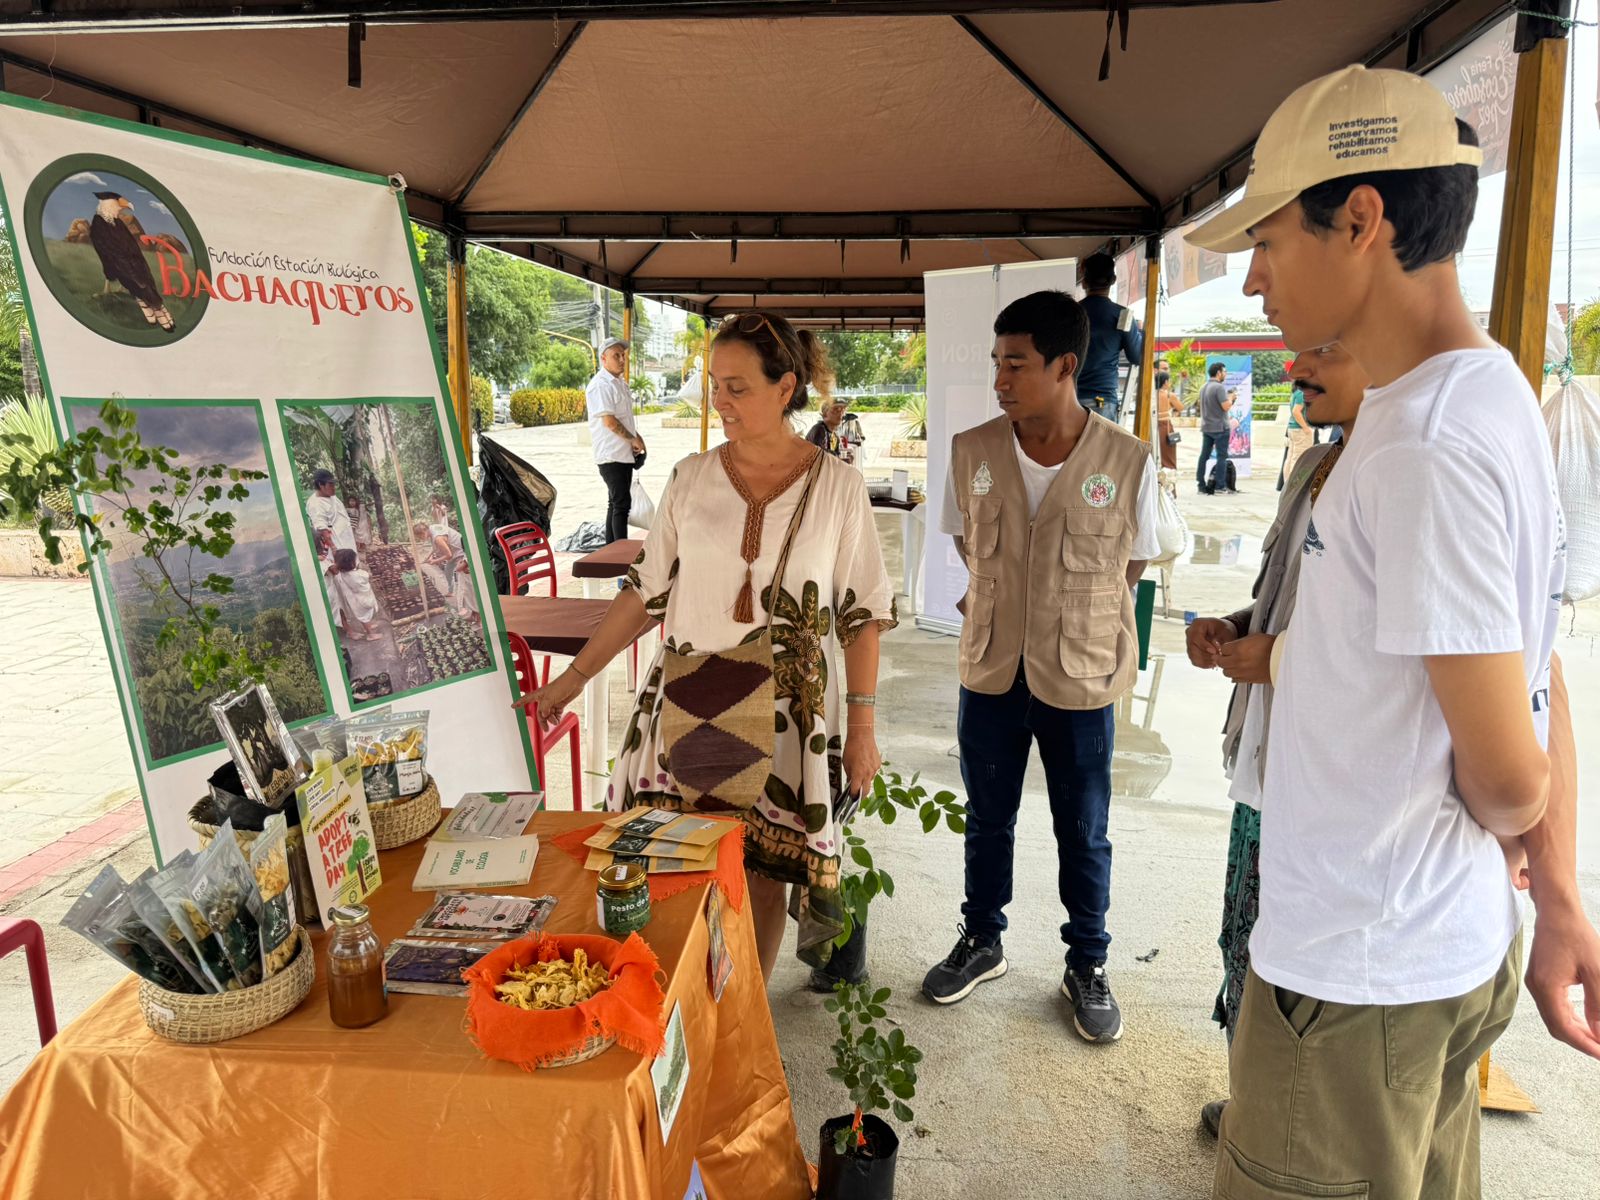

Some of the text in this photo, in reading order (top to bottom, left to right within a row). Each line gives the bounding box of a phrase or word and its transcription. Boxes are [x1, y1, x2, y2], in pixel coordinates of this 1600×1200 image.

[1328, 126, 1399, 142] conservamos
[1328, 136, 1398, 151] rehabilitamos
[1335, 146, 1389, 160] educamos
[208, 246, 380, 283] Fundación Estación Biológica
[317, 811, 349, 853] ADOPT
[321, 853, 331, 871] A
[328, 830, 353, 864] TREE
[325, 862, 346, 889] DAY
[611, 898, 646, 912] Pesto de
